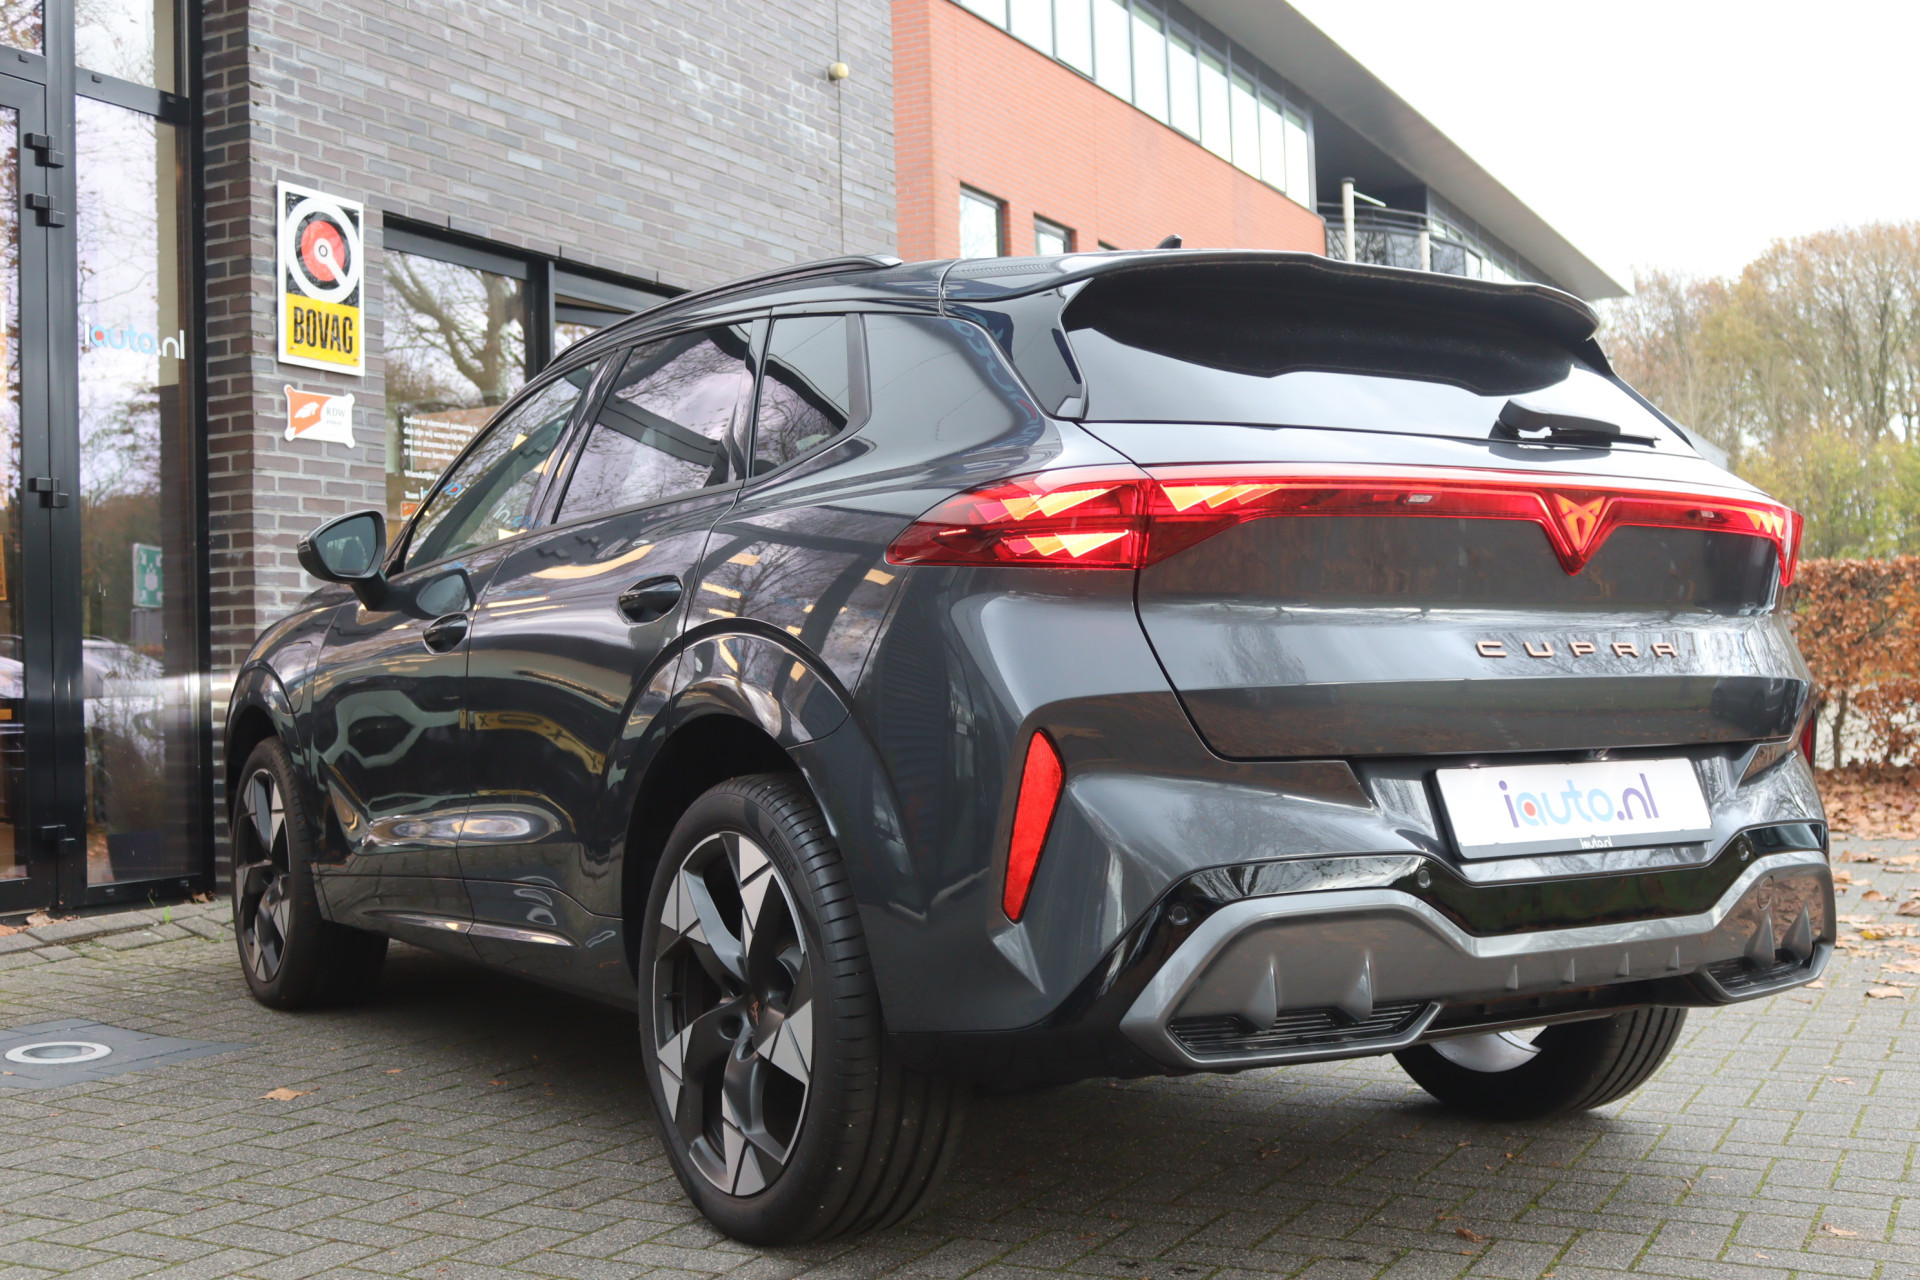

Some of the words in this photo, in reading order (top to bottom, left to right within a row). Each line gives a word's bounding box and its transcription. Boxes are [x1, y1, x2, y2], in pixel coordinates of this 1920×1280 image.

[83, 314, 185, 360] iauto.nl
[293, 305, 353, 354] BOVAG
[326, 407, 346, 417] RDW
[1475, 640, 1679, 658] CUPRA
[1498, 773, 1660, 829] iauto.nl
